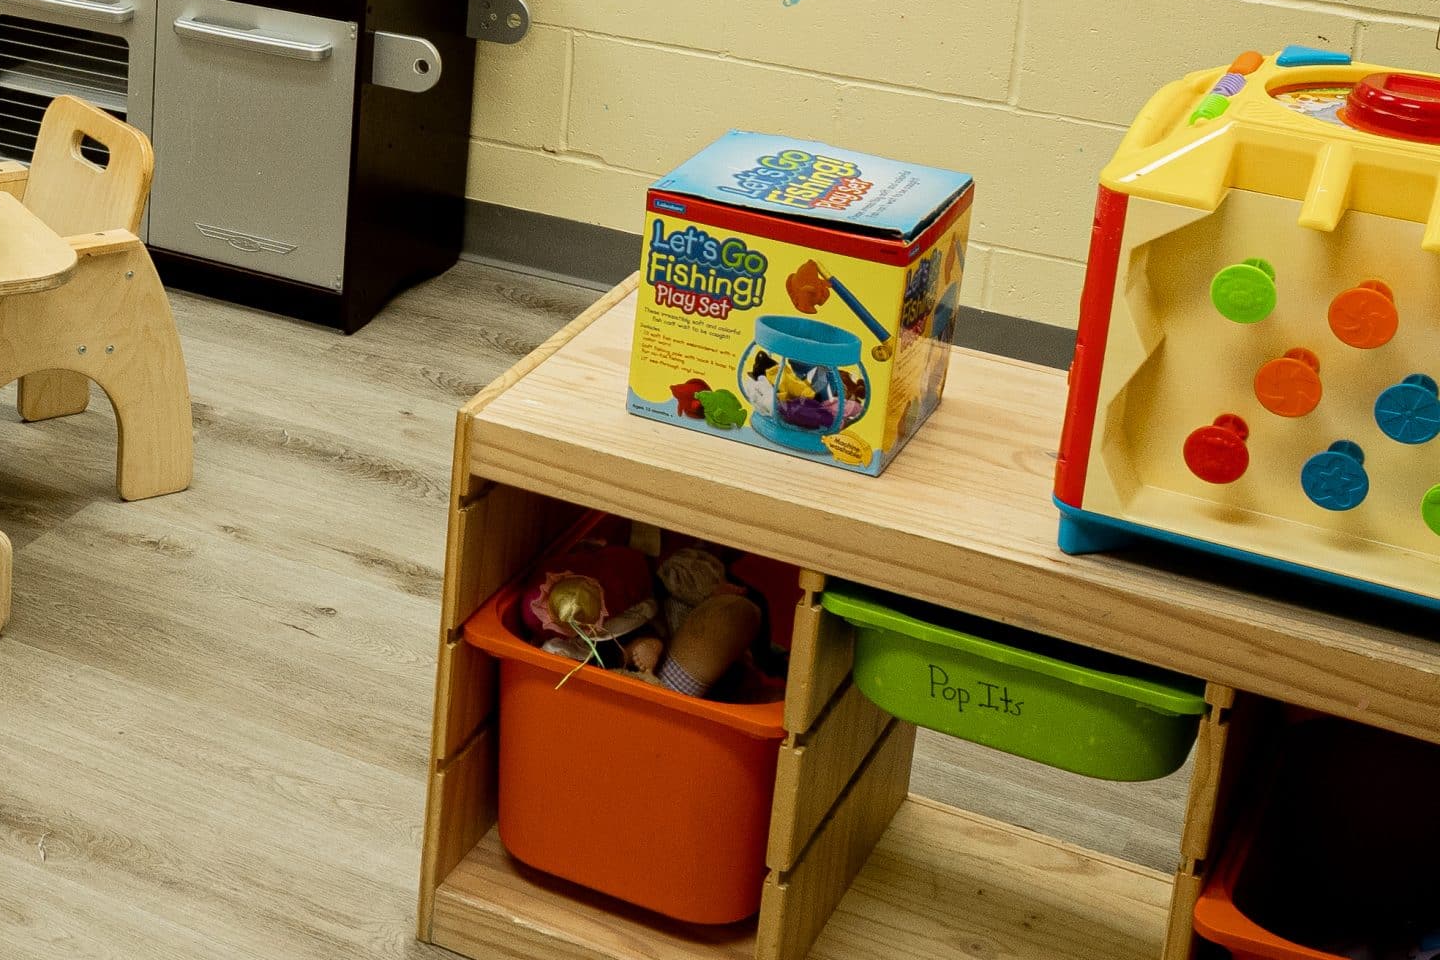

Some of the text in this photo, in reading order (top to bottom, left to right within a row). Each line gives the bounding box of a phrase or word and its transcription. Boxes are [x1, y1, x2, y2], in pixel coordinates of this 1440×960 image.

[718, 150, 810, 198] Let's Go
[766, 155, 855, 208] Fishing!
[815, 178, 872, 209] Play Set
[653, 222, 764, 273] Let's Go
[650, 251, 762, 306] Fishing!
[657, 284, 730, 317] Play Set
[928, 664, 1025, 716] Pop Its
